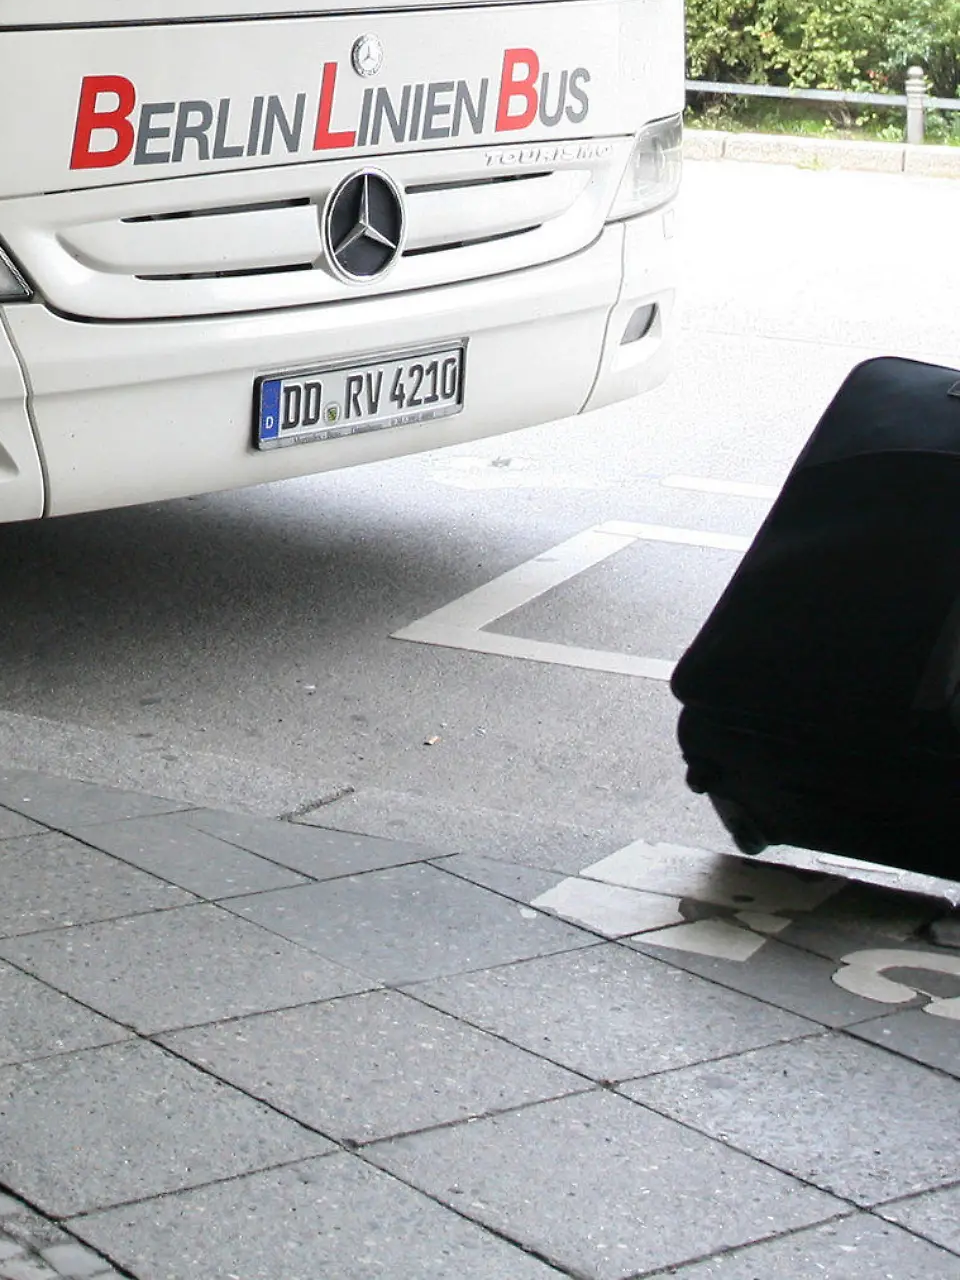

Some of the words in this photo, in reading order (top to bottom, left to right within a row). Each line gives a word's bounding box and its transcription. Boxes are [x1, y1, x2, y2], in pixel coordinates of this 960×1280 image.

[69, 75, 307, 171] BERLIN
[313, 62, 489, 151] LINIEN
[494, 47, 592, 133] BUS
[484, 145, 614, 167] TOURISMO
[281, 380, 323, 430] DD
[344, 370, 384, 419] RV
[389, 356, 458, 410] 4210
[265, 416, 274, 429] D
